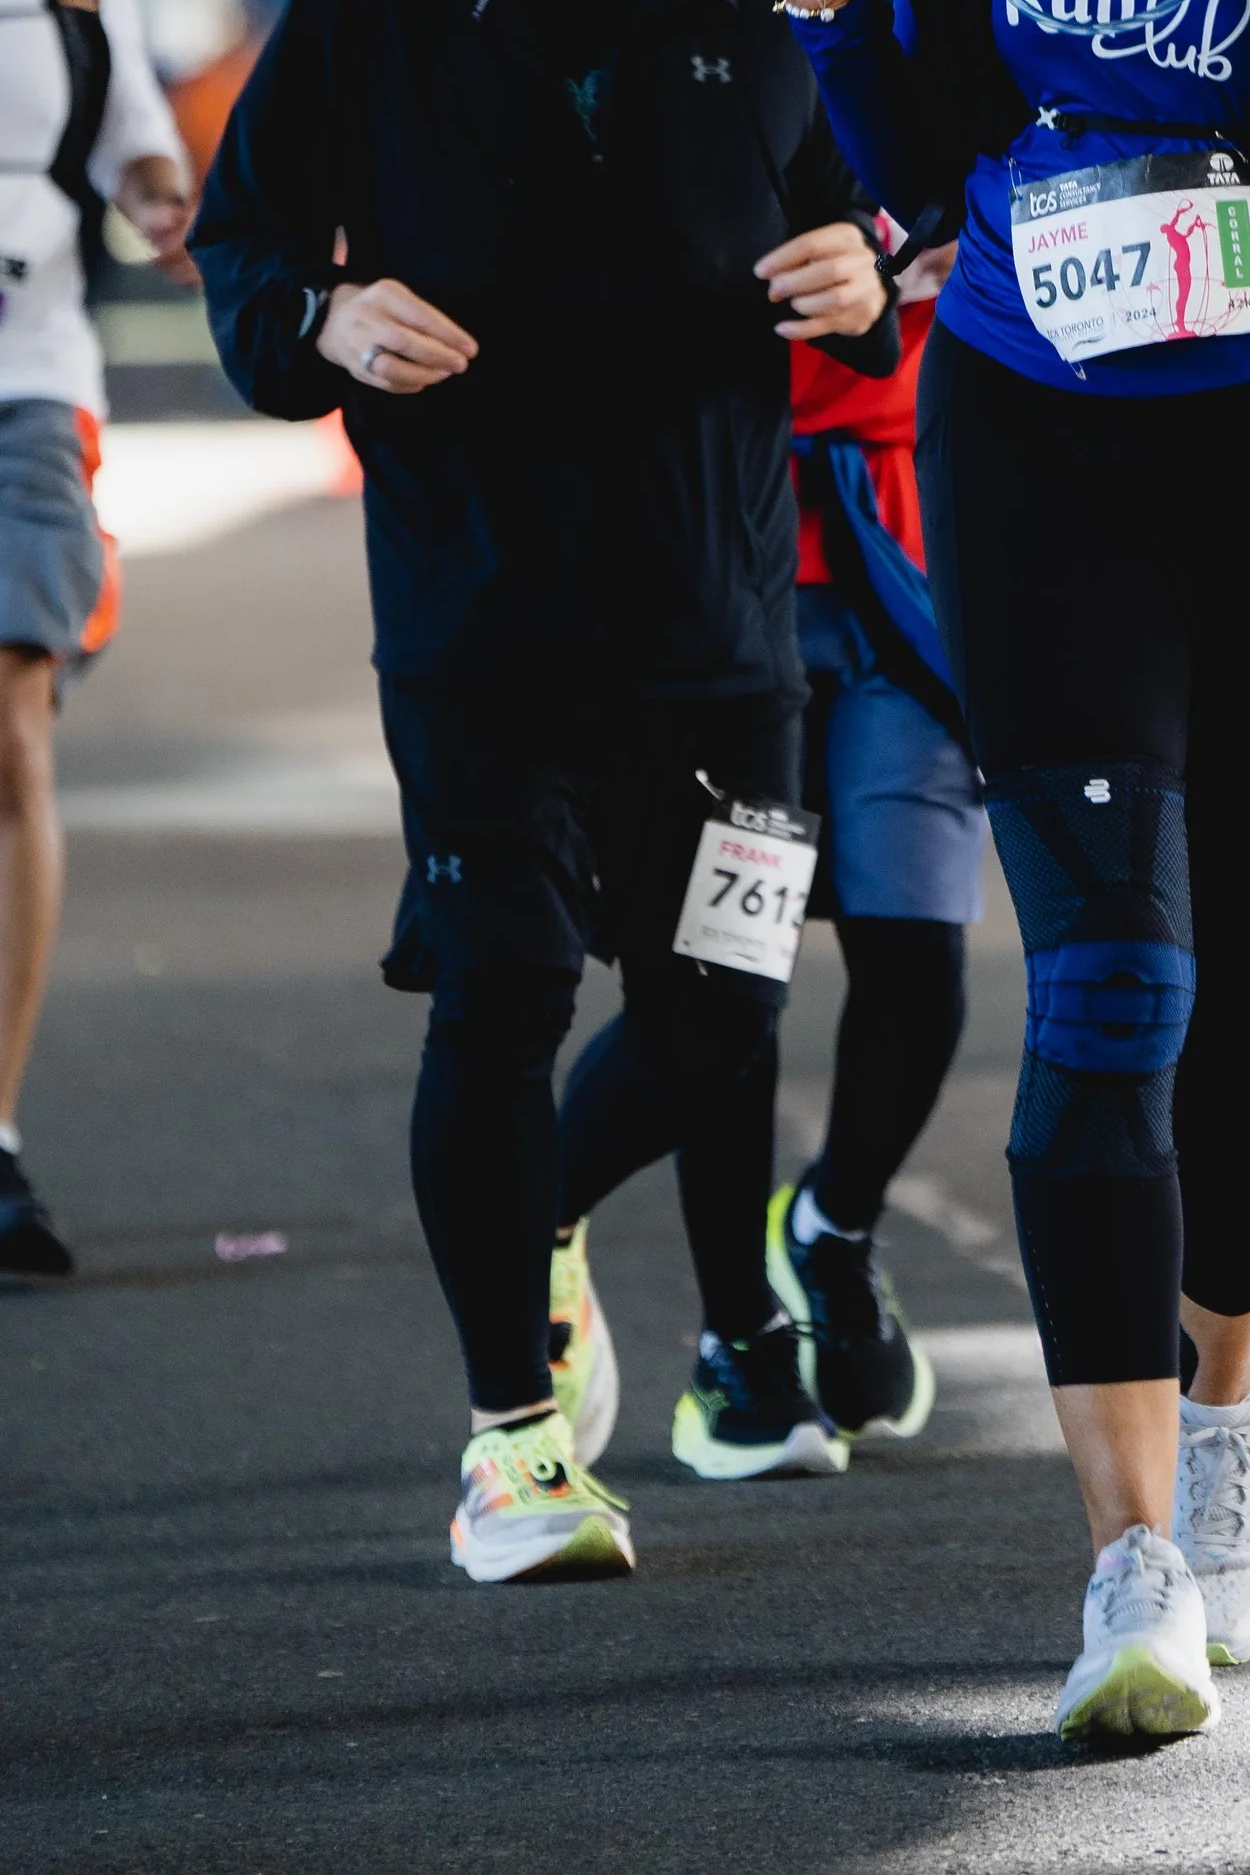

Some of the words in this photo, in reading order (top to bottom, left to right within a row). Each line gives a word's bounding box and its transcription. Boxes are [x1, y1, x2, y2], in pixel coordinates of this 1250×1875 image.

[1059, 180, 1078, 192] TATA
[1207, 172, 1241, 185] TATA
[1059, 181, 1101, 200] CONSULTANCY
[1028, 221, 1089, 253] JAYME
[1227, 205, 1244, 280] CORRAL
[1032, 240, 1152, 309] 5047
[1125, 307, 1156, 322] 2024
[1060, 316, 1104, 337] TORONTO
